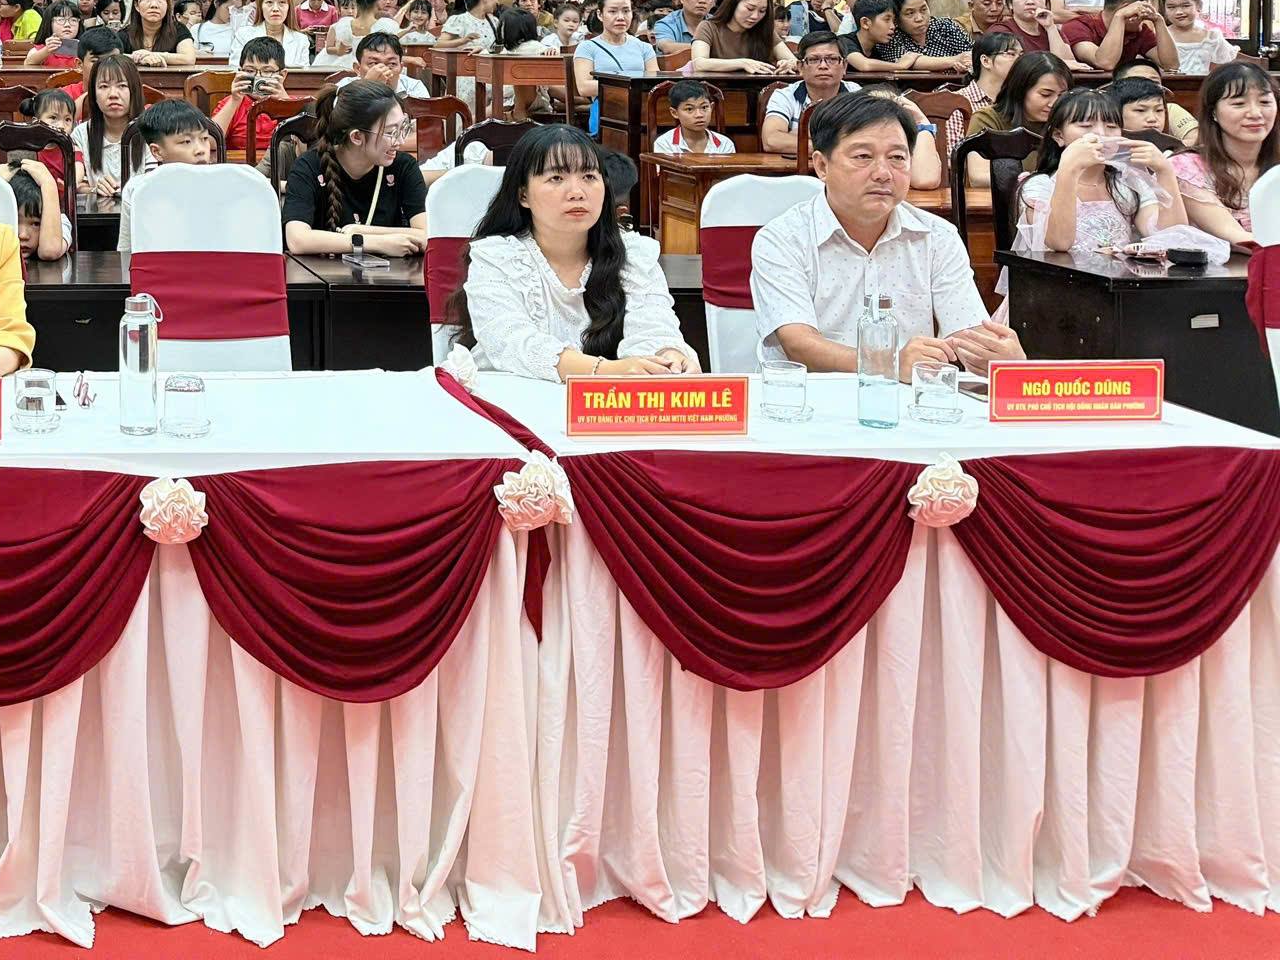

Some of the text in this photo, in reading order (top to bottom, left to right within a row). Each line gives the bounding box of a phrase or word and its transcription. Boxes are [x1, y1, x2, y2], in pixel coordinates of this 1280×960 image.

[1023, 377, 1131, 396] NGÔ QUỐC DŨNG
[637, 392, 665, 411] THỊ
[671, 392, 705, 408] KIM
[712, 388, 732, 407] LÊ
